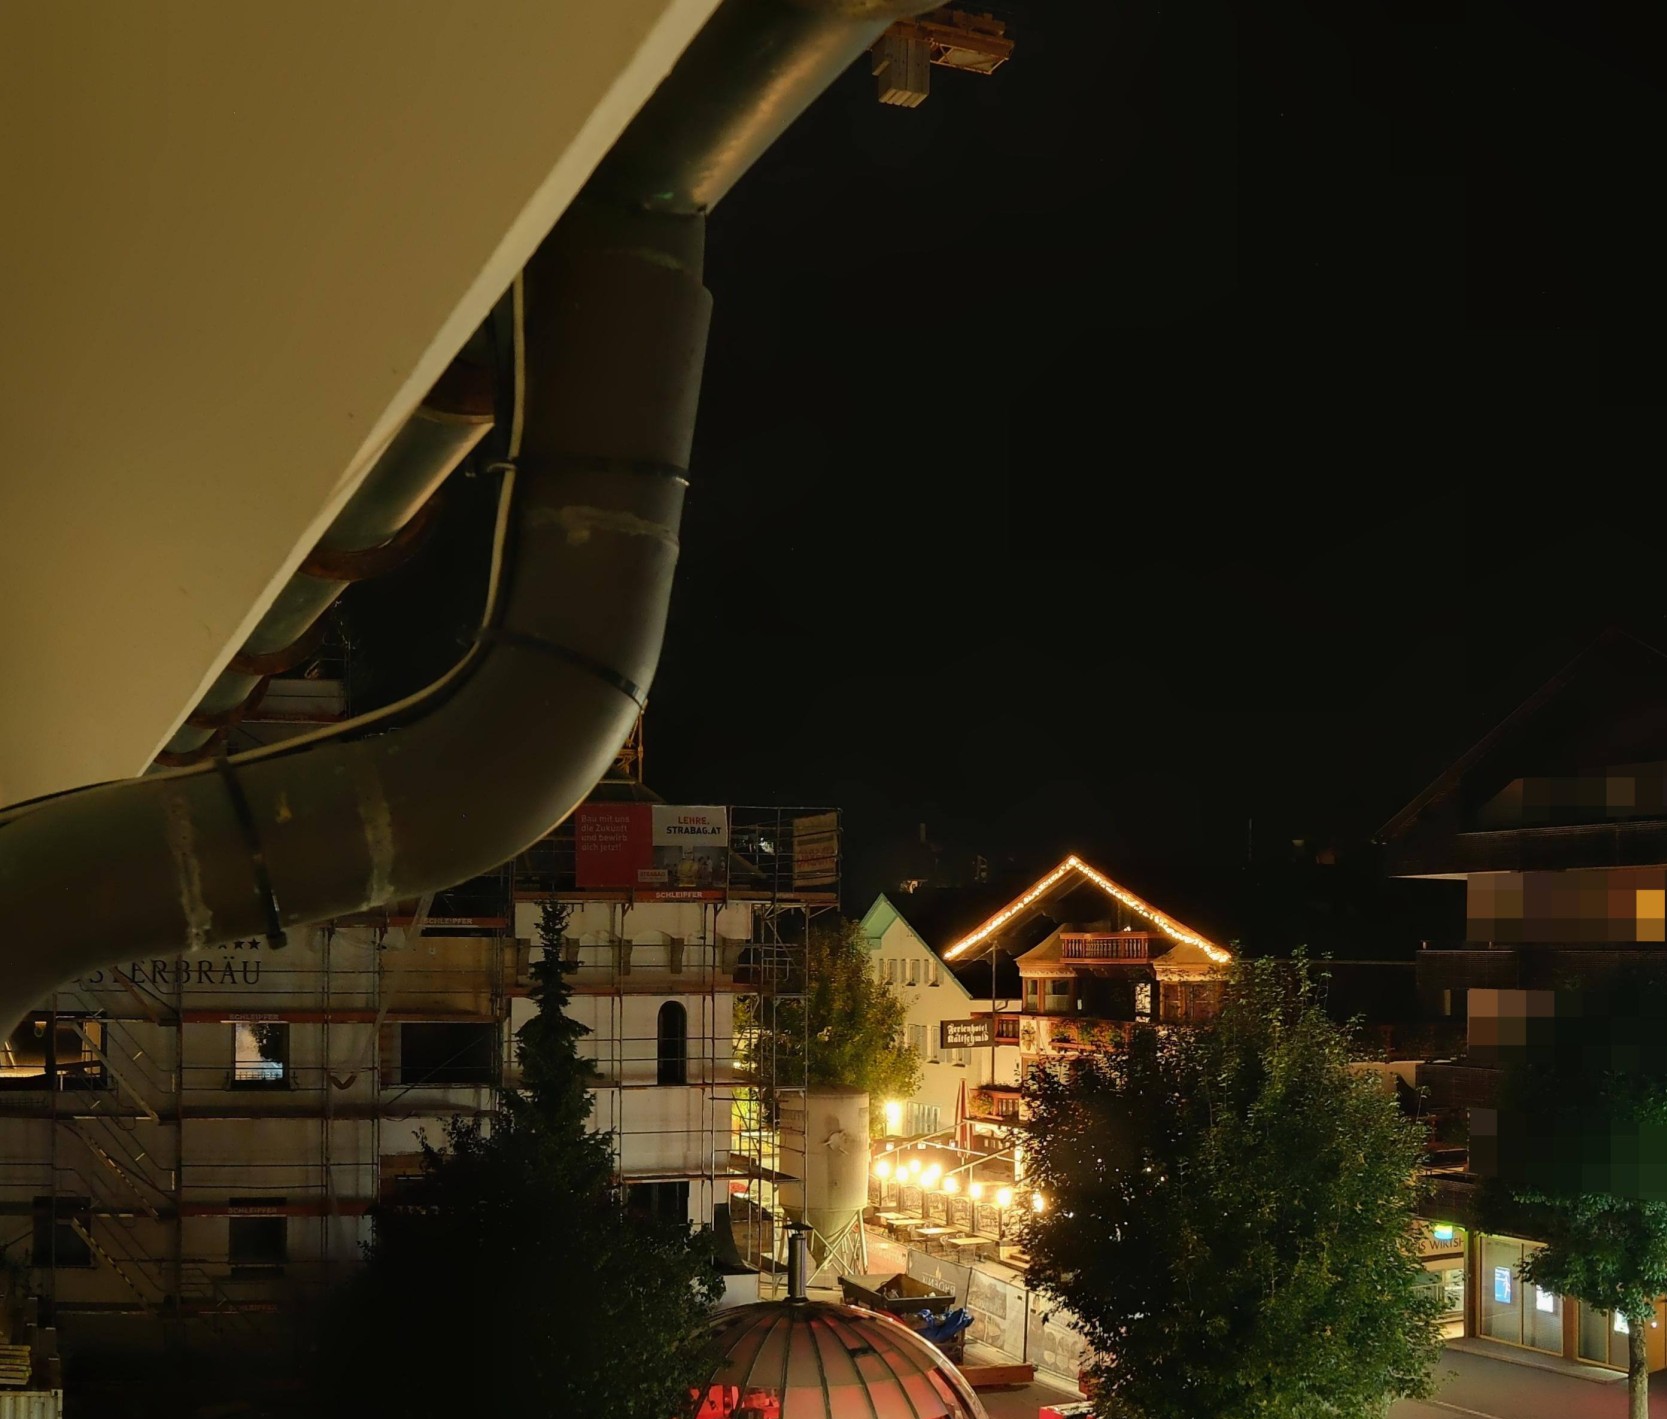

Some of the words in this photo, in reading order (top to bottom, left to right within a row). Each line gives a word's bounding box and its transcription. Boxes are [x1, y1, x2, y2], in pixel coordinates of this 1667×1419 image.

[581, 815, 596, 823] Bau
[598, 815, 613, 823] mit
[677, 816, 710, 825] LEHRE.
[581, 824, 594, 833] die
[596, 824, 628, 833] Zukunft
[666, 825, 722, 835] STRABAG.AT
[581, 833, 597, 842] und
[598, 833, 628, 842] bewirb
[581, 842, 598, 851] dich
